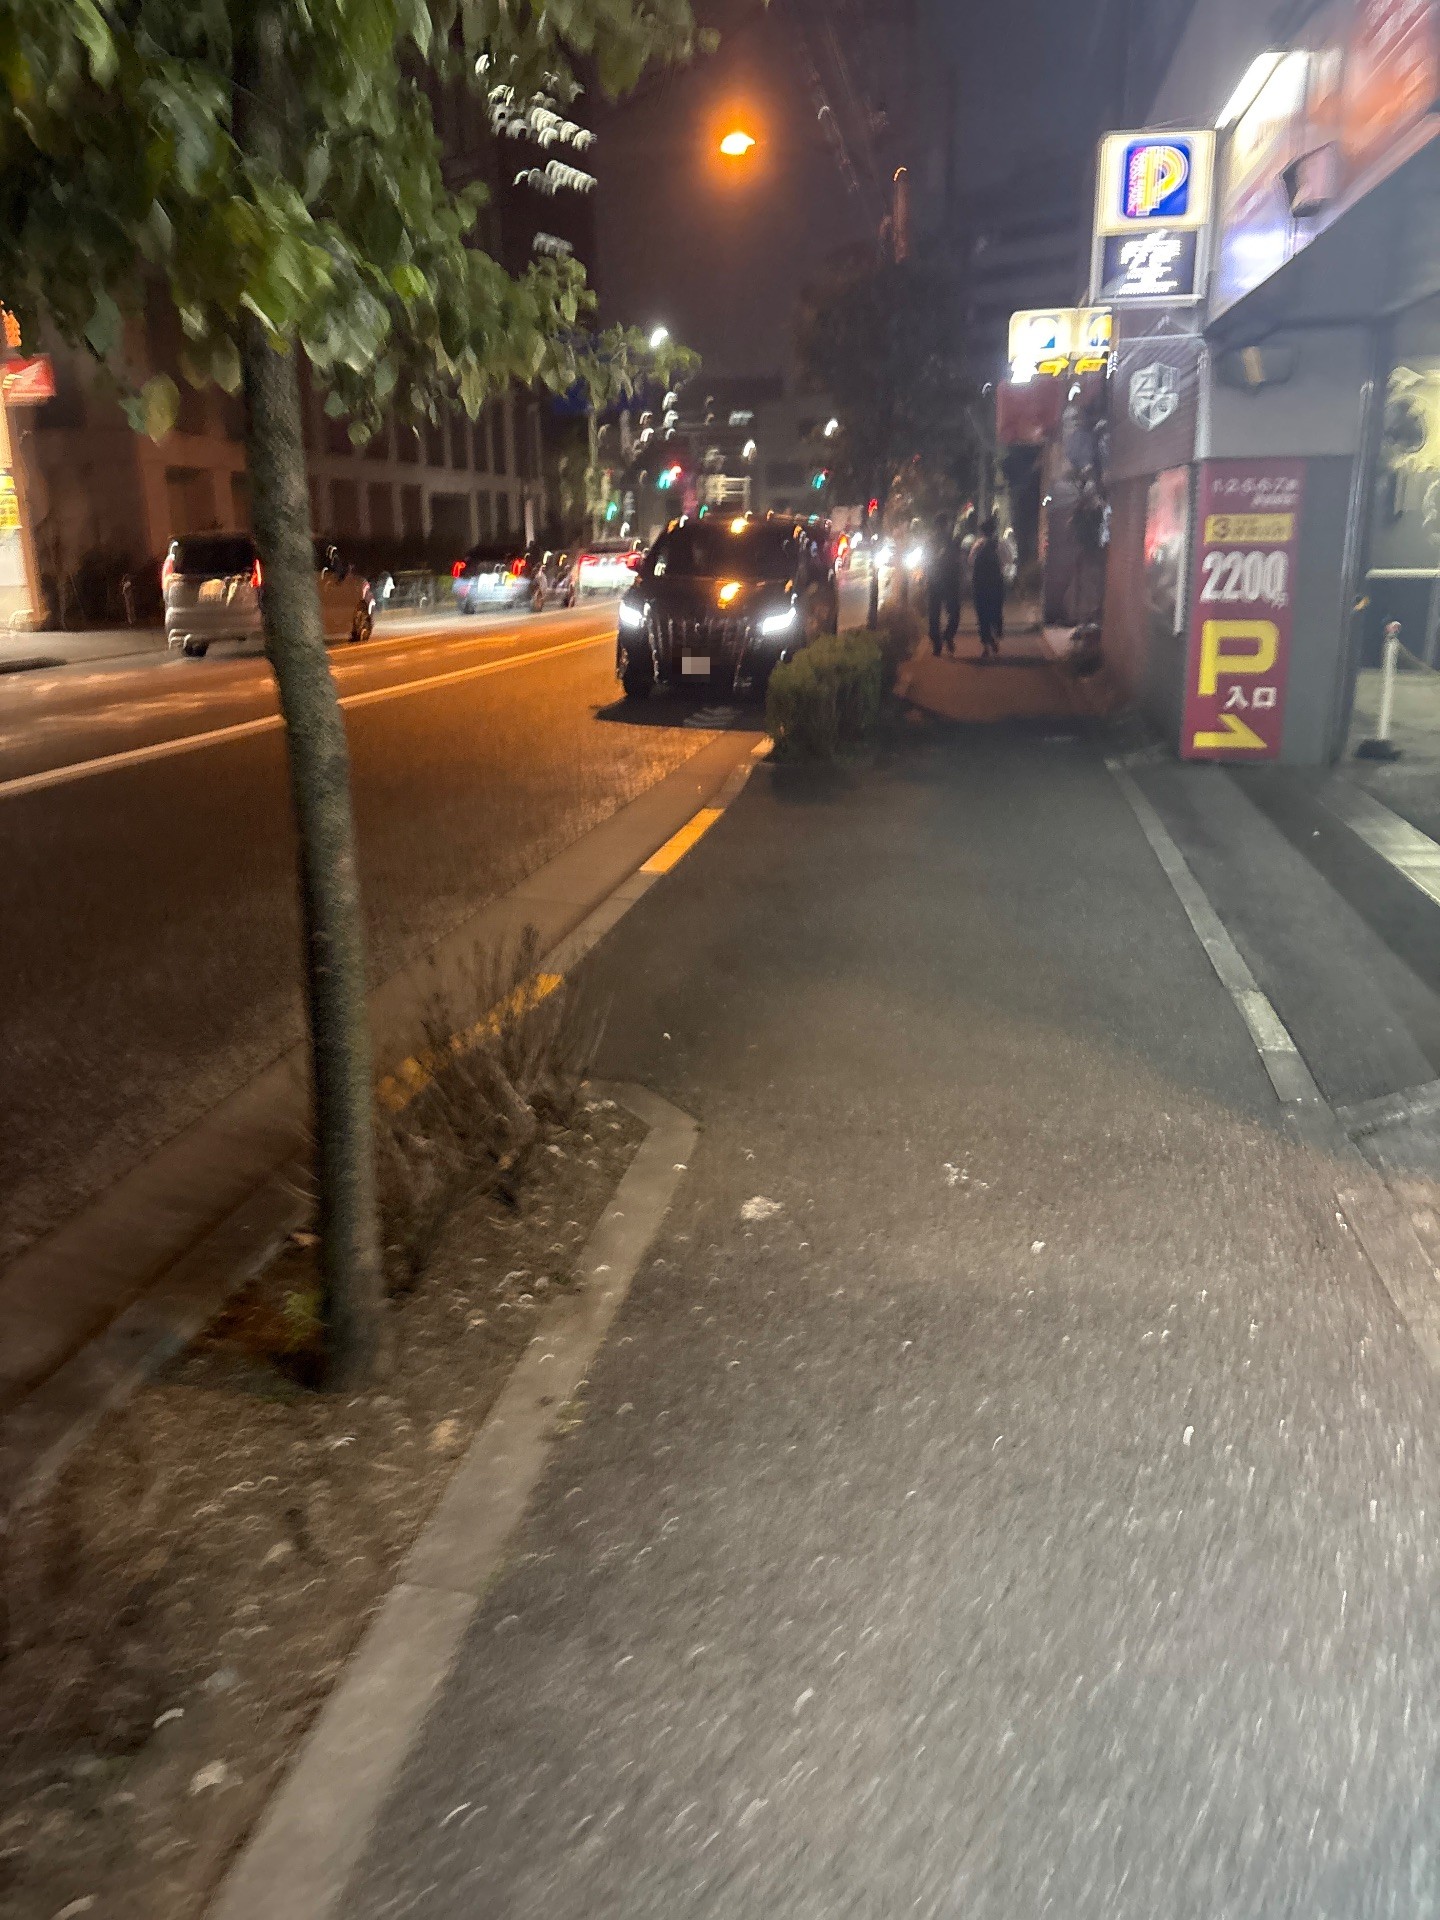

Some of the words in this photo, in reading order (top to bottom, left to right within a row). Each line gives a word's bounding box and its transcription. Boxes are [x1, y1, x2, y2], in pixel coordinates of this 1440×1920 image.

[1127, 145, 1189, 217] P
[1119, 229, 1181, 295] 空
[1198, 619, 1279, 695] P
[1224, 686, 1277, 709] 入口
